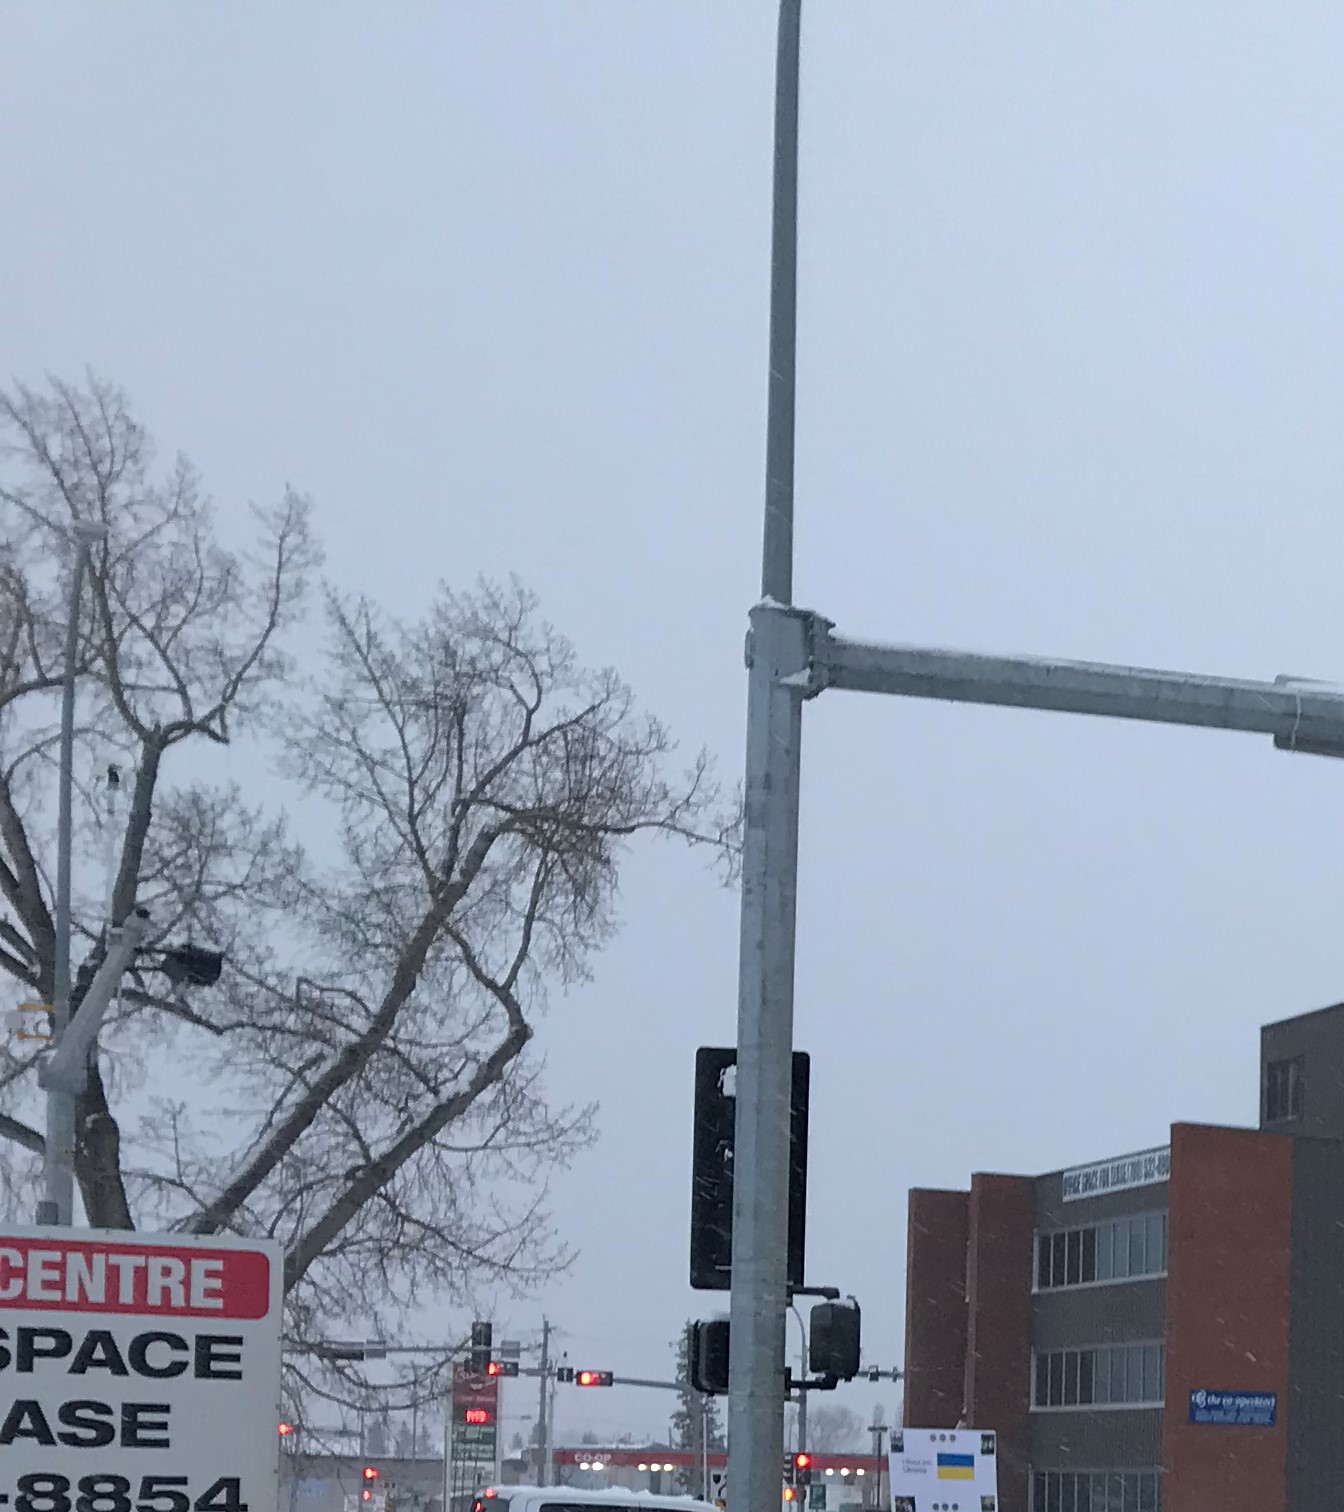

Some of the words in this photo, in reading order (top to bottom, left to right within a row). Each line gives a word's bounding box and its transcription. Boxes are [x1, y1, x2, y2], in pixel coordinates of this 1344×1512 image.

[0, 1246, 224, 1309] CENTRE
[0, 1326, 244, 1380] PACE
[574, 1452, 612, 1463] CO-OP
